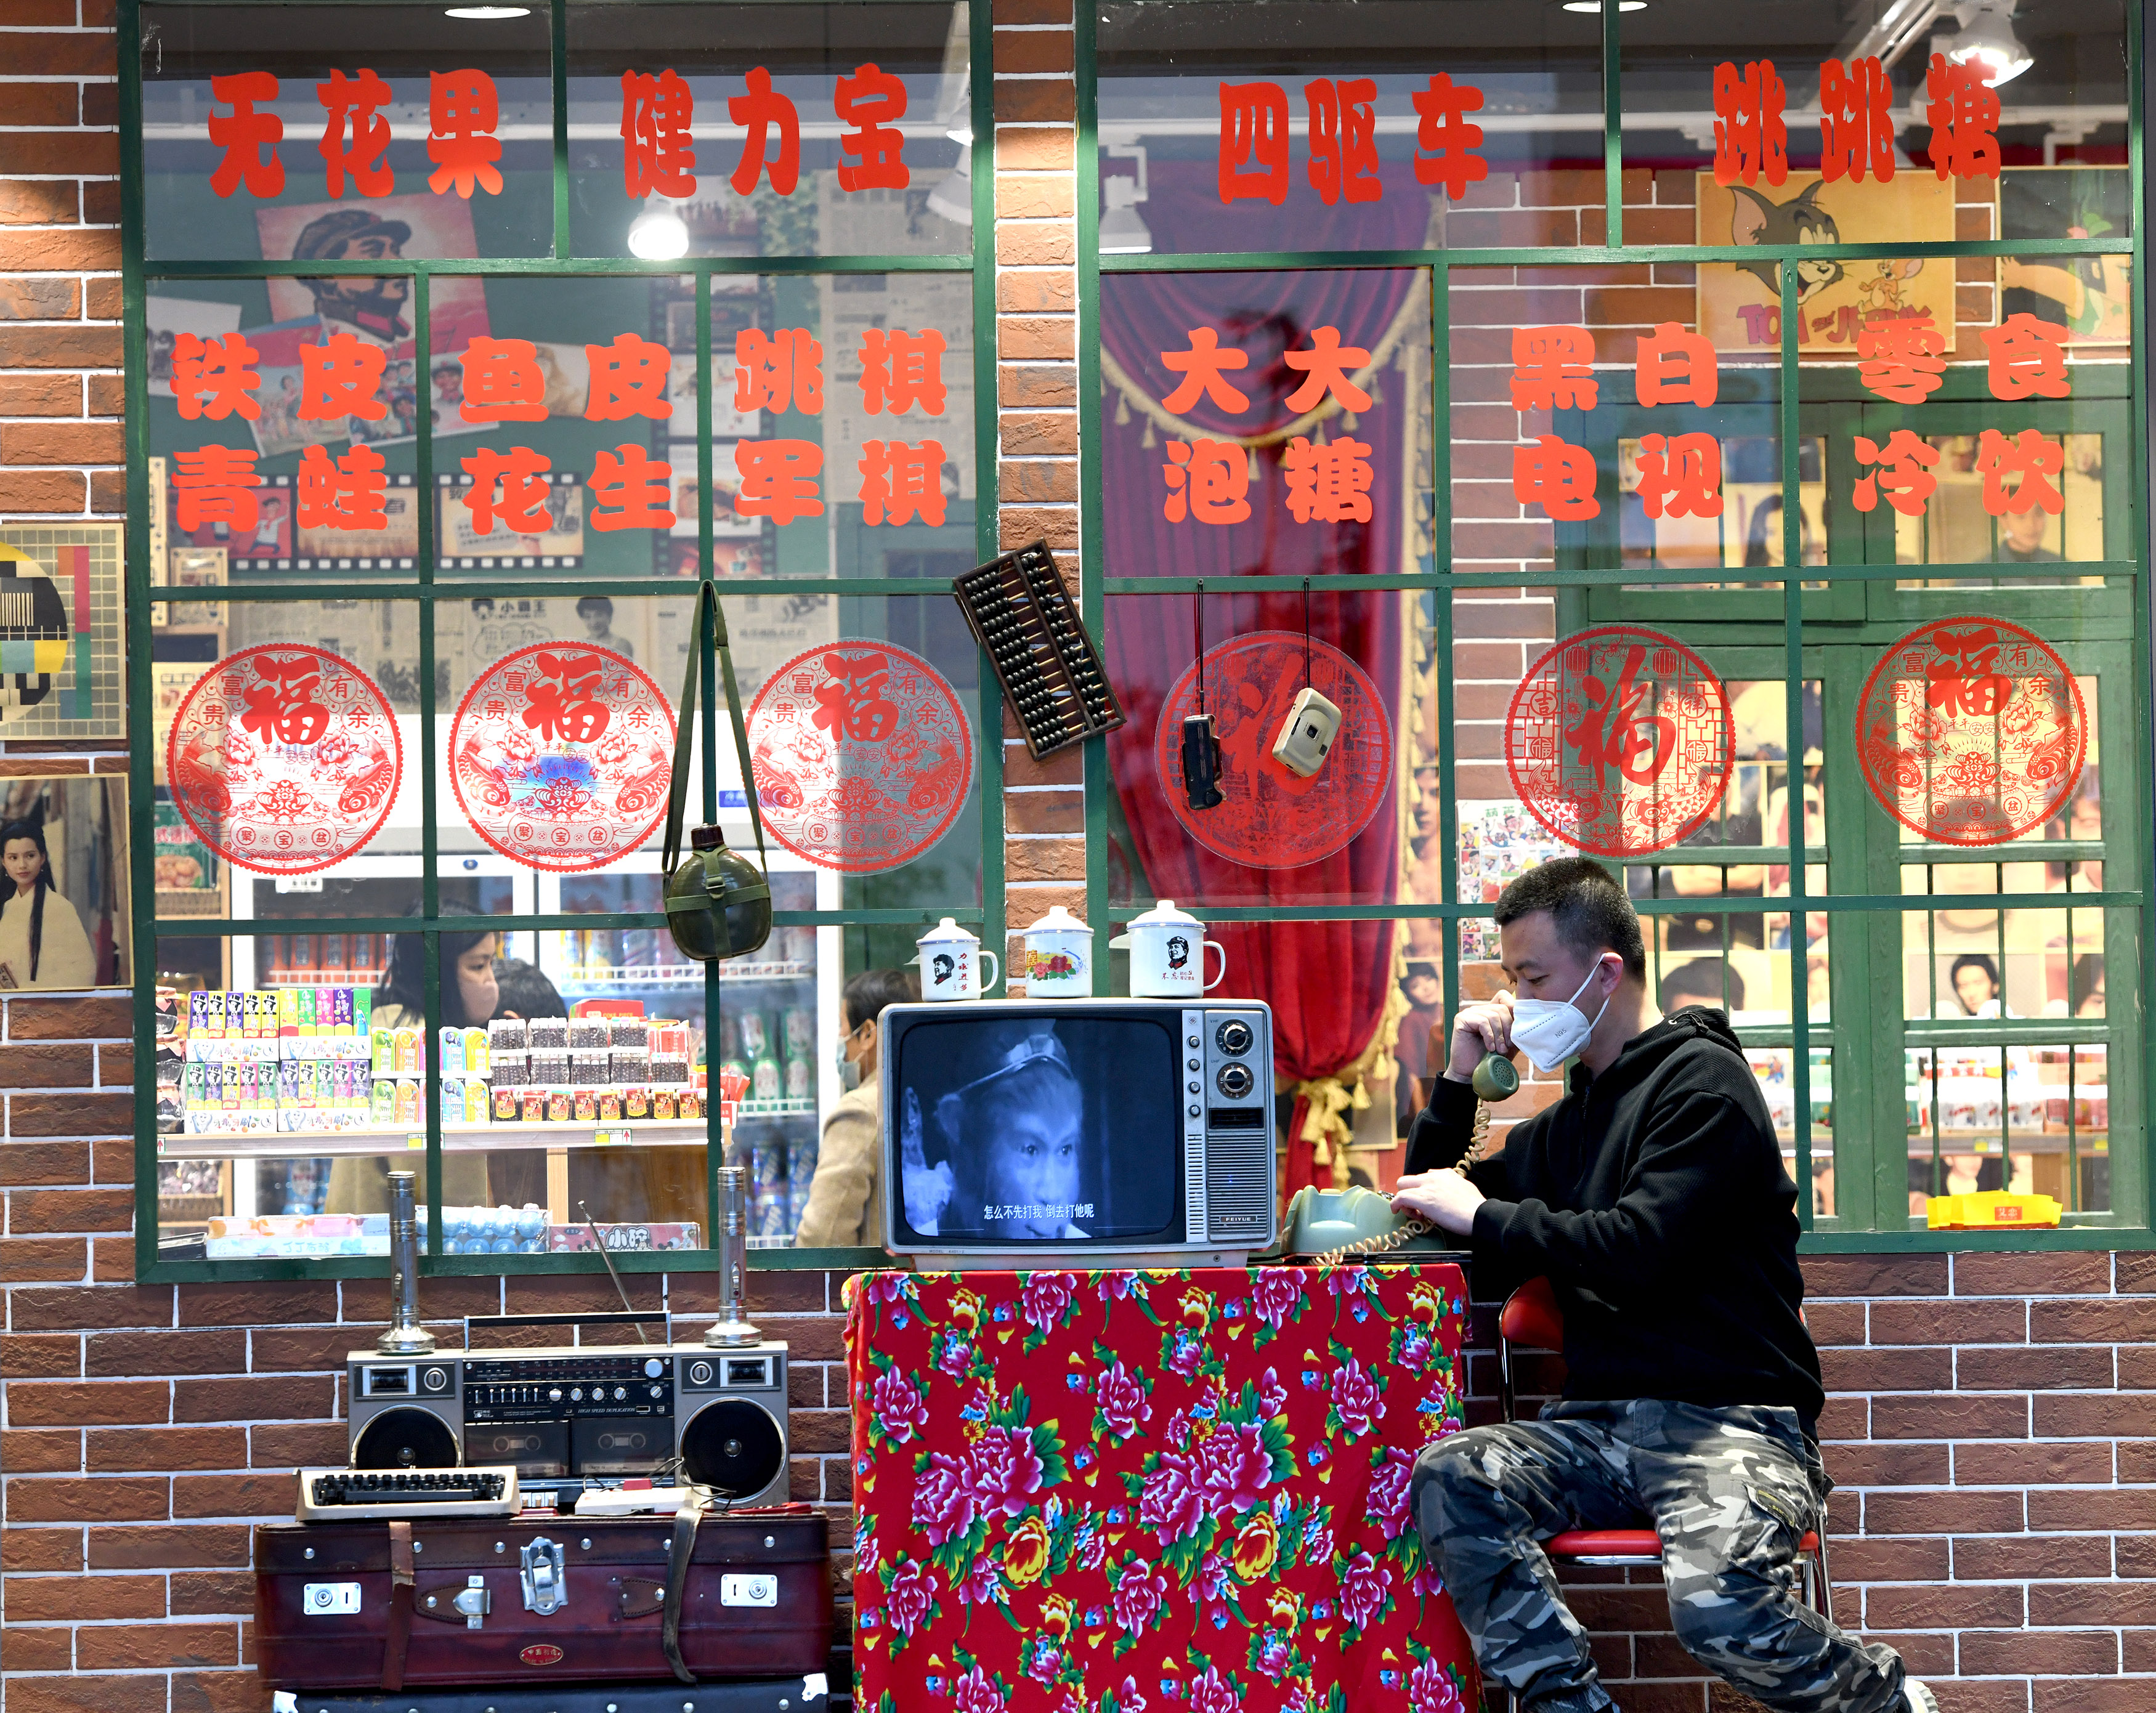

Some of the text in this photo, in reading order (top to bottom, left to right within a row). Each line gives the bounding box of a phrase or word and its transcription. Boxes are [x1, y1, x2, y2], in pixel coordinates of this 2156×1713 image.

[209, 68, 503, 199] 无花果
[621, 63, 910, 199] 健力宝
[1218, 72, 1488, 206] 四驱车
[1714, 53, 2001, 187] 跳跳糖
[170, 333, 387, 421] 铁皮
[458, 333, 673, 423] 鱼皮
[735, 328, 947, 416] 跳棋
[1161, 326, 1373, 414] 大大
[1510, 321, 1718, 411] 黑白
[1856, 313, 2071, 404] 零食
[171, 444, 388, 532] 青蛙
[461, 444, 676, 535] 花生
[734, 439, 947, 527] 军棋
[1163, 436, 1374, 525] 泡糖
[1513, 433, 1724, 520] 电视
[1853, 429, 2065, 516] 冷饮
[241, 655, 330, 745] 福
[522, 652, 610, 743] 福
[811, 653, 899, 743] 福
[1925, 627, 2012, 718] 福
[1564, 644, 1676, 792] 福
[242, 829, 327, 846] 聚宝盆
[518, 827, 604, 843] 聚宝盆
[813, 827, 899, 843] 聚宝盆
[1934, 800, 2020, 817] 聚宝盆
[984, 1204, 1095, 1220] 怎么不先打我 倒去打他呢
